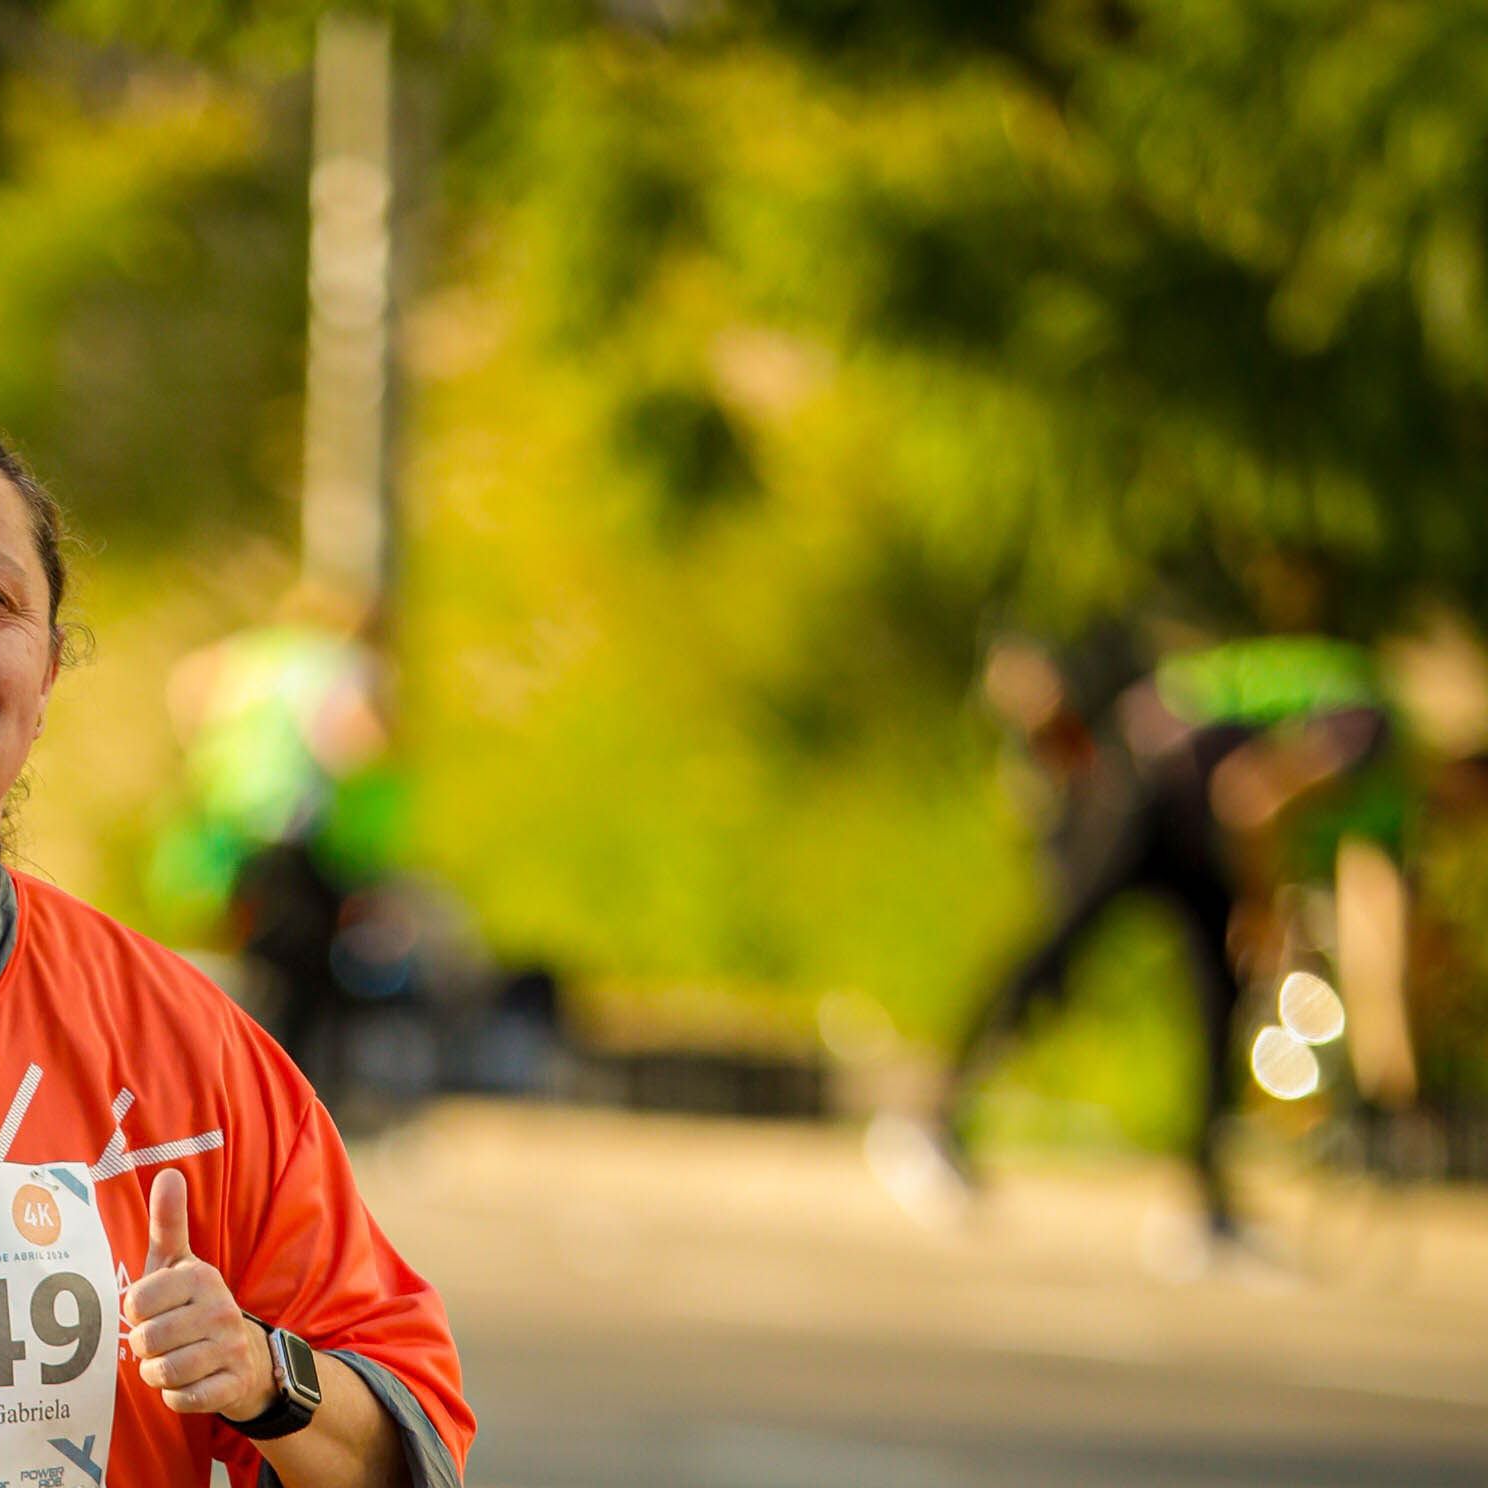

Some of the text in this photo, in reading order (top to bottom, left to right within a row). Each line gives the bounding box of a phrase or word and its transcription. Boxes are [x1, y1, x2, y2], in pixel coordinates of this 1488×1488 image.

[23, 1202, 55, 1228] 4K
[14, 1252, 44, 1261] ABRIL
[20, 1466, 65, 1481] POWER
